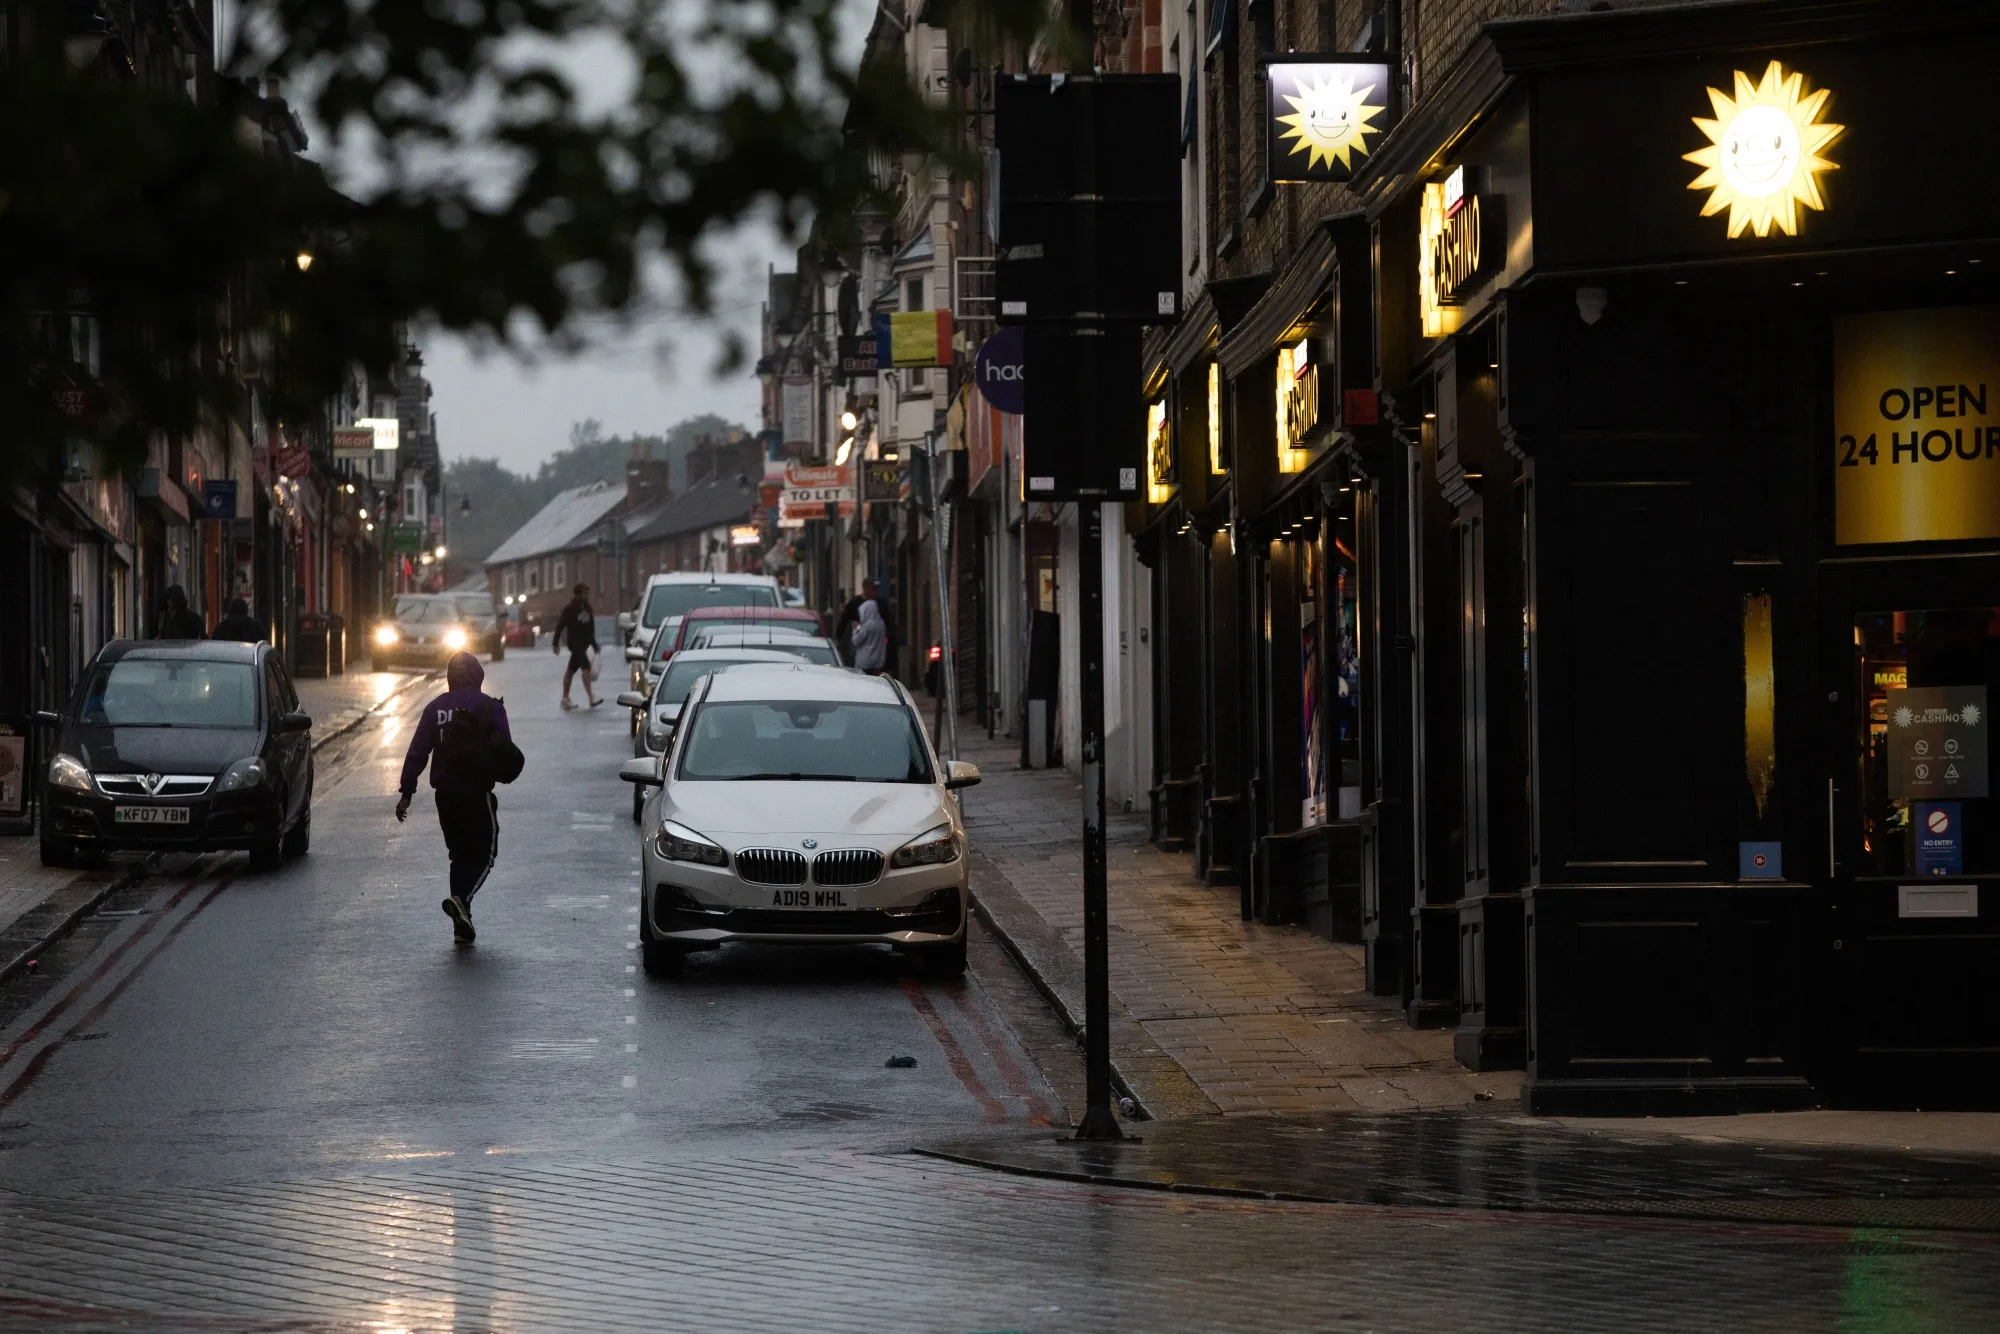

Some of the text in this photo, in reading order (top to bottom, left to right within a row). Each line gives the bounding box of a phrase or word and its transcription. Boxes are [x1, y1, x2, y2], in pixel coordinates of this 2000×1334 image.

[1432, 194, 1480, 306] CASHINO
[52, 390, 85, 404] JUST
[1879, 383, 1987, 421] OPEN
[1839, 432, 1879, 467] 24
[790, 489, 840, 500] TO LET
[1914, 713, 1960, 724] CASHINO
[123, 808, 158, 821] KF07
[772, 890, 847, 906] AD19 WHL
